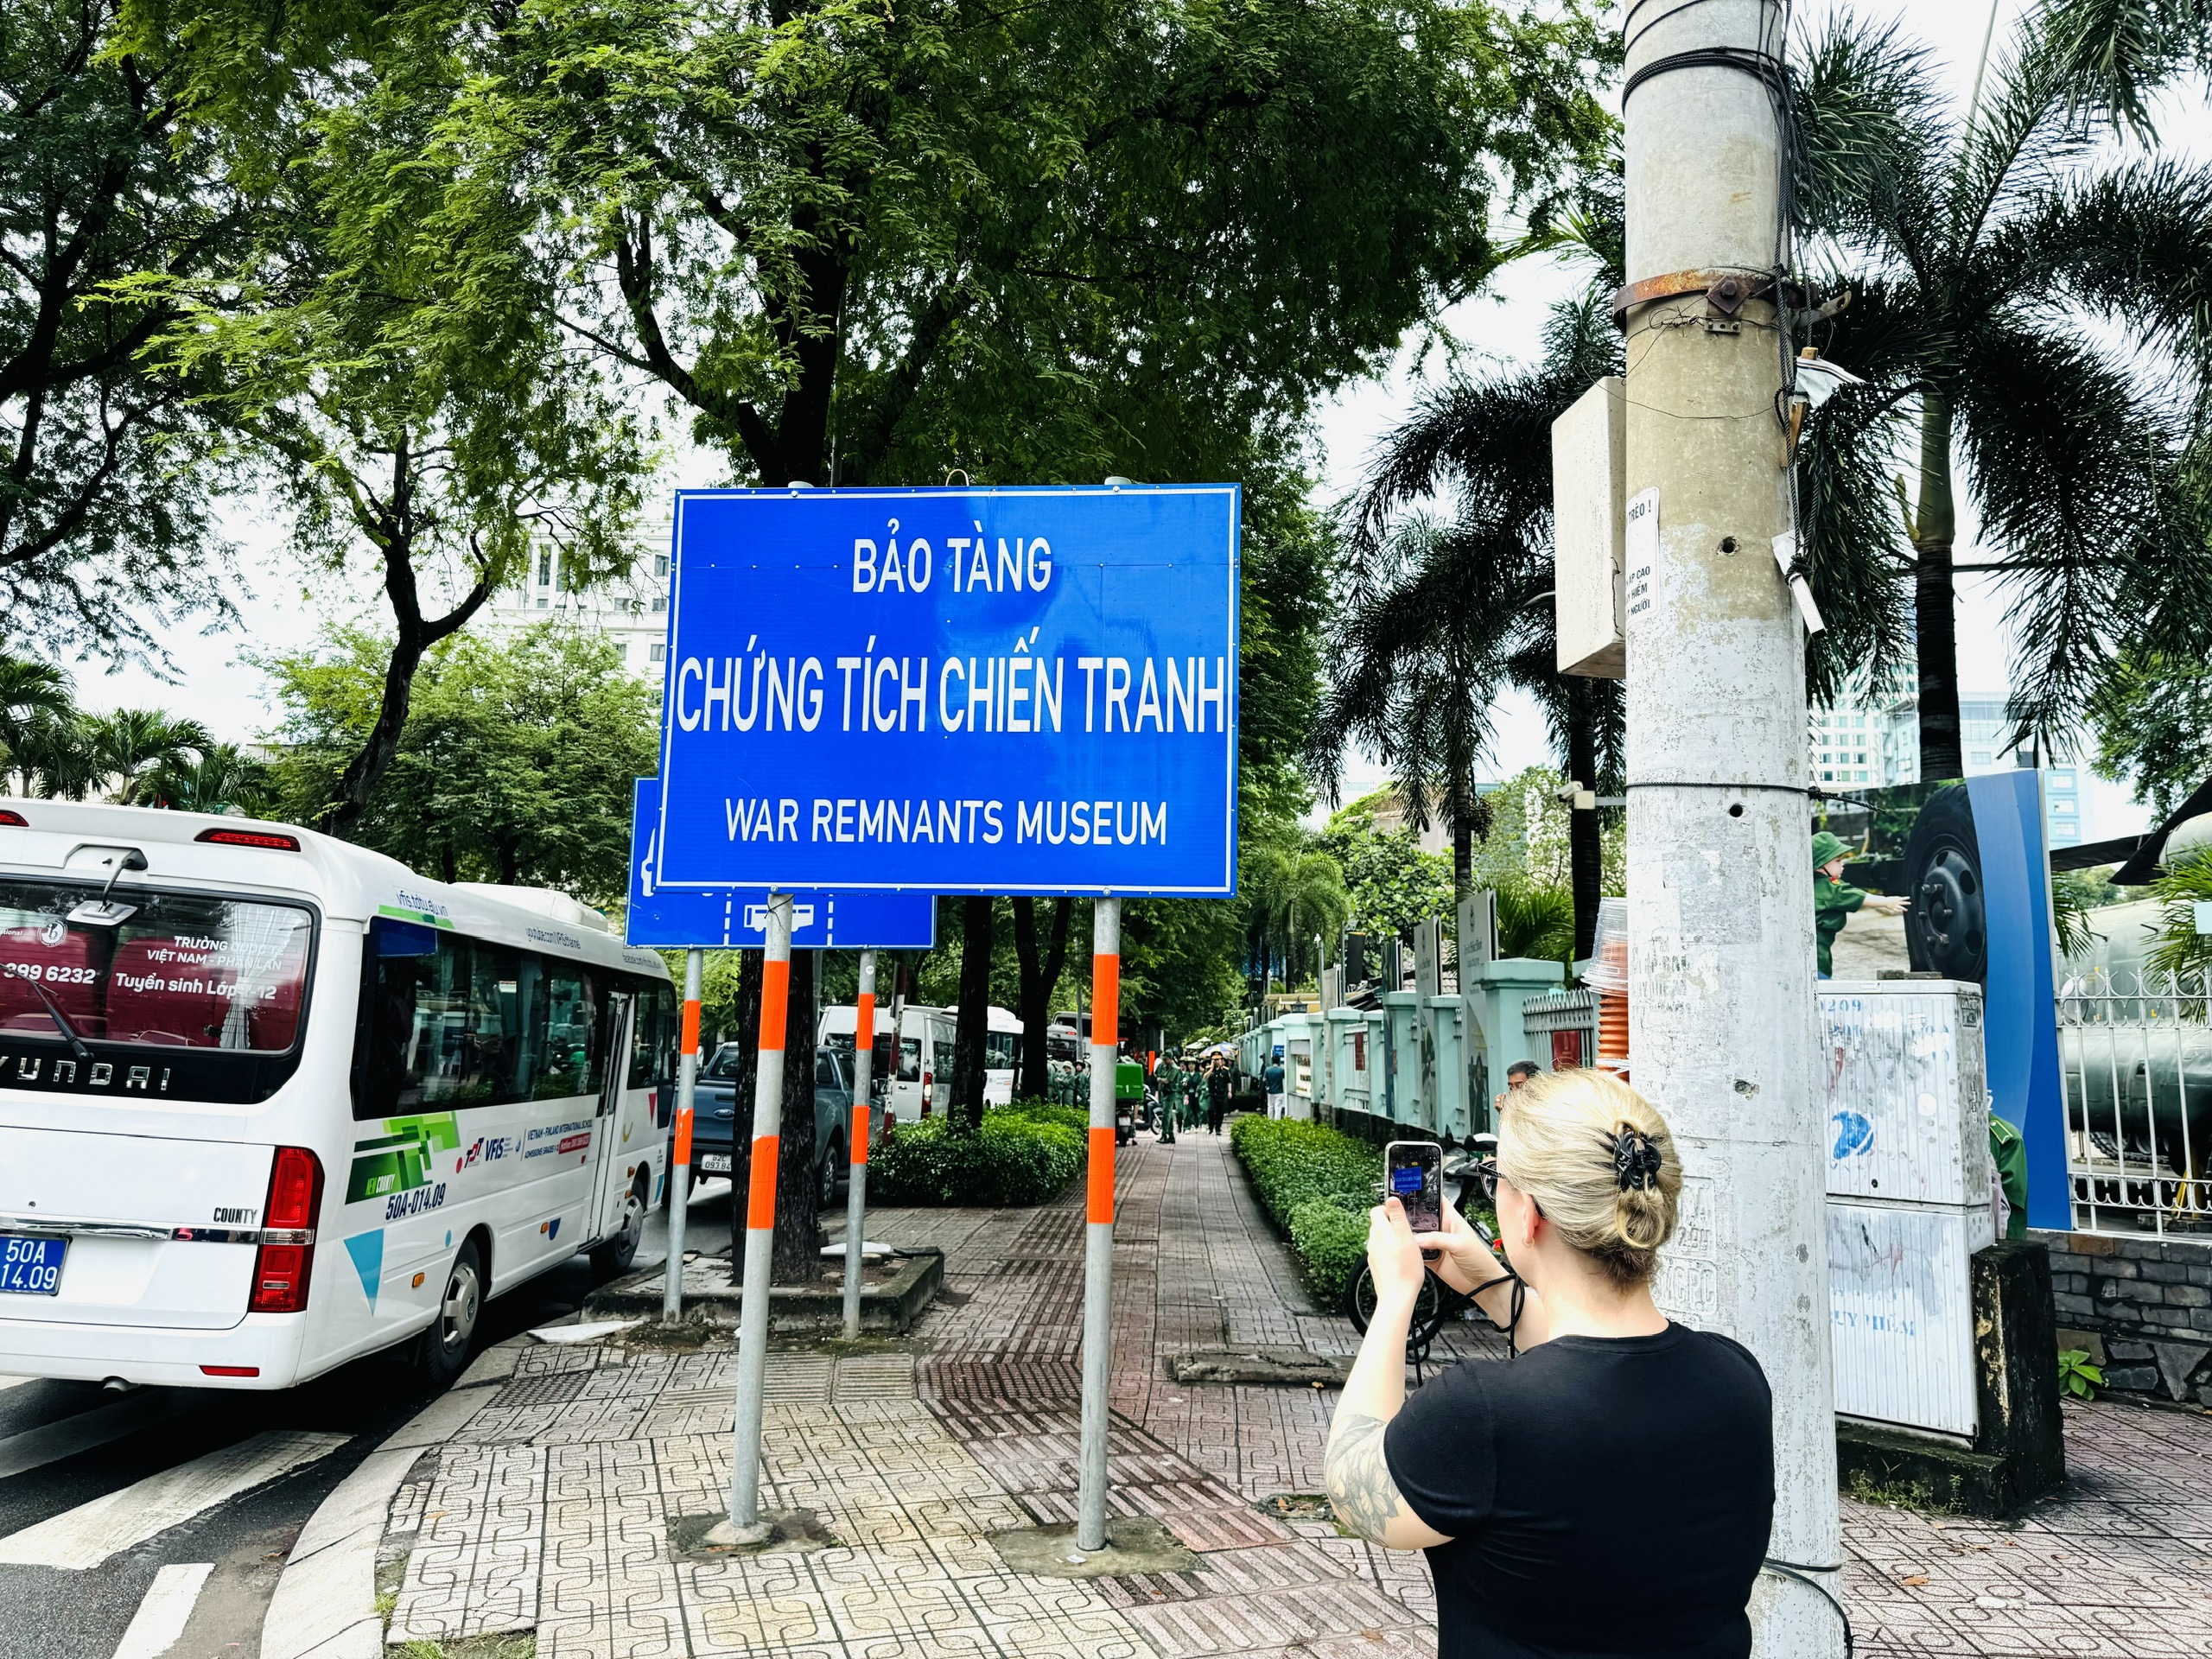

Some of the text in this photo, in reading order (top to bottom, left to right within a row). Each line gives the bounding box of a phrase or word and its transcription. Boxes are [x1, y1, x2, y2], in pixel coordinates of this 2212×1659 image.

[854, 518, 1052, 592] BẢO TÀNG
[1637, 566, 1650, 579] CAO
[677, 626, 1224, 732] CHỨNG TÍCH CHIẾN TRANH
[726, 798, 1166, 844] WAR REMNANTS MUSEUM
[175, 936, 228, 951] TRƯỜNG
[147, 949, 175, 963] VIỆT
[177, 954, 207, 964] NAM
[46, 966, 96, 985] 6232
[116, 972, 165, 993] Tuyển
[168, 977, 203, 994] sinh
[207, 980, 238, 1000] Lớp
[385, 1183, 446, 1220] 50A-014.09
[213, 1207, 258, 1224] COUNTY
[6, 1240, 46, 1264] 50A
[1, 1263, 58, 1290] 14.09
